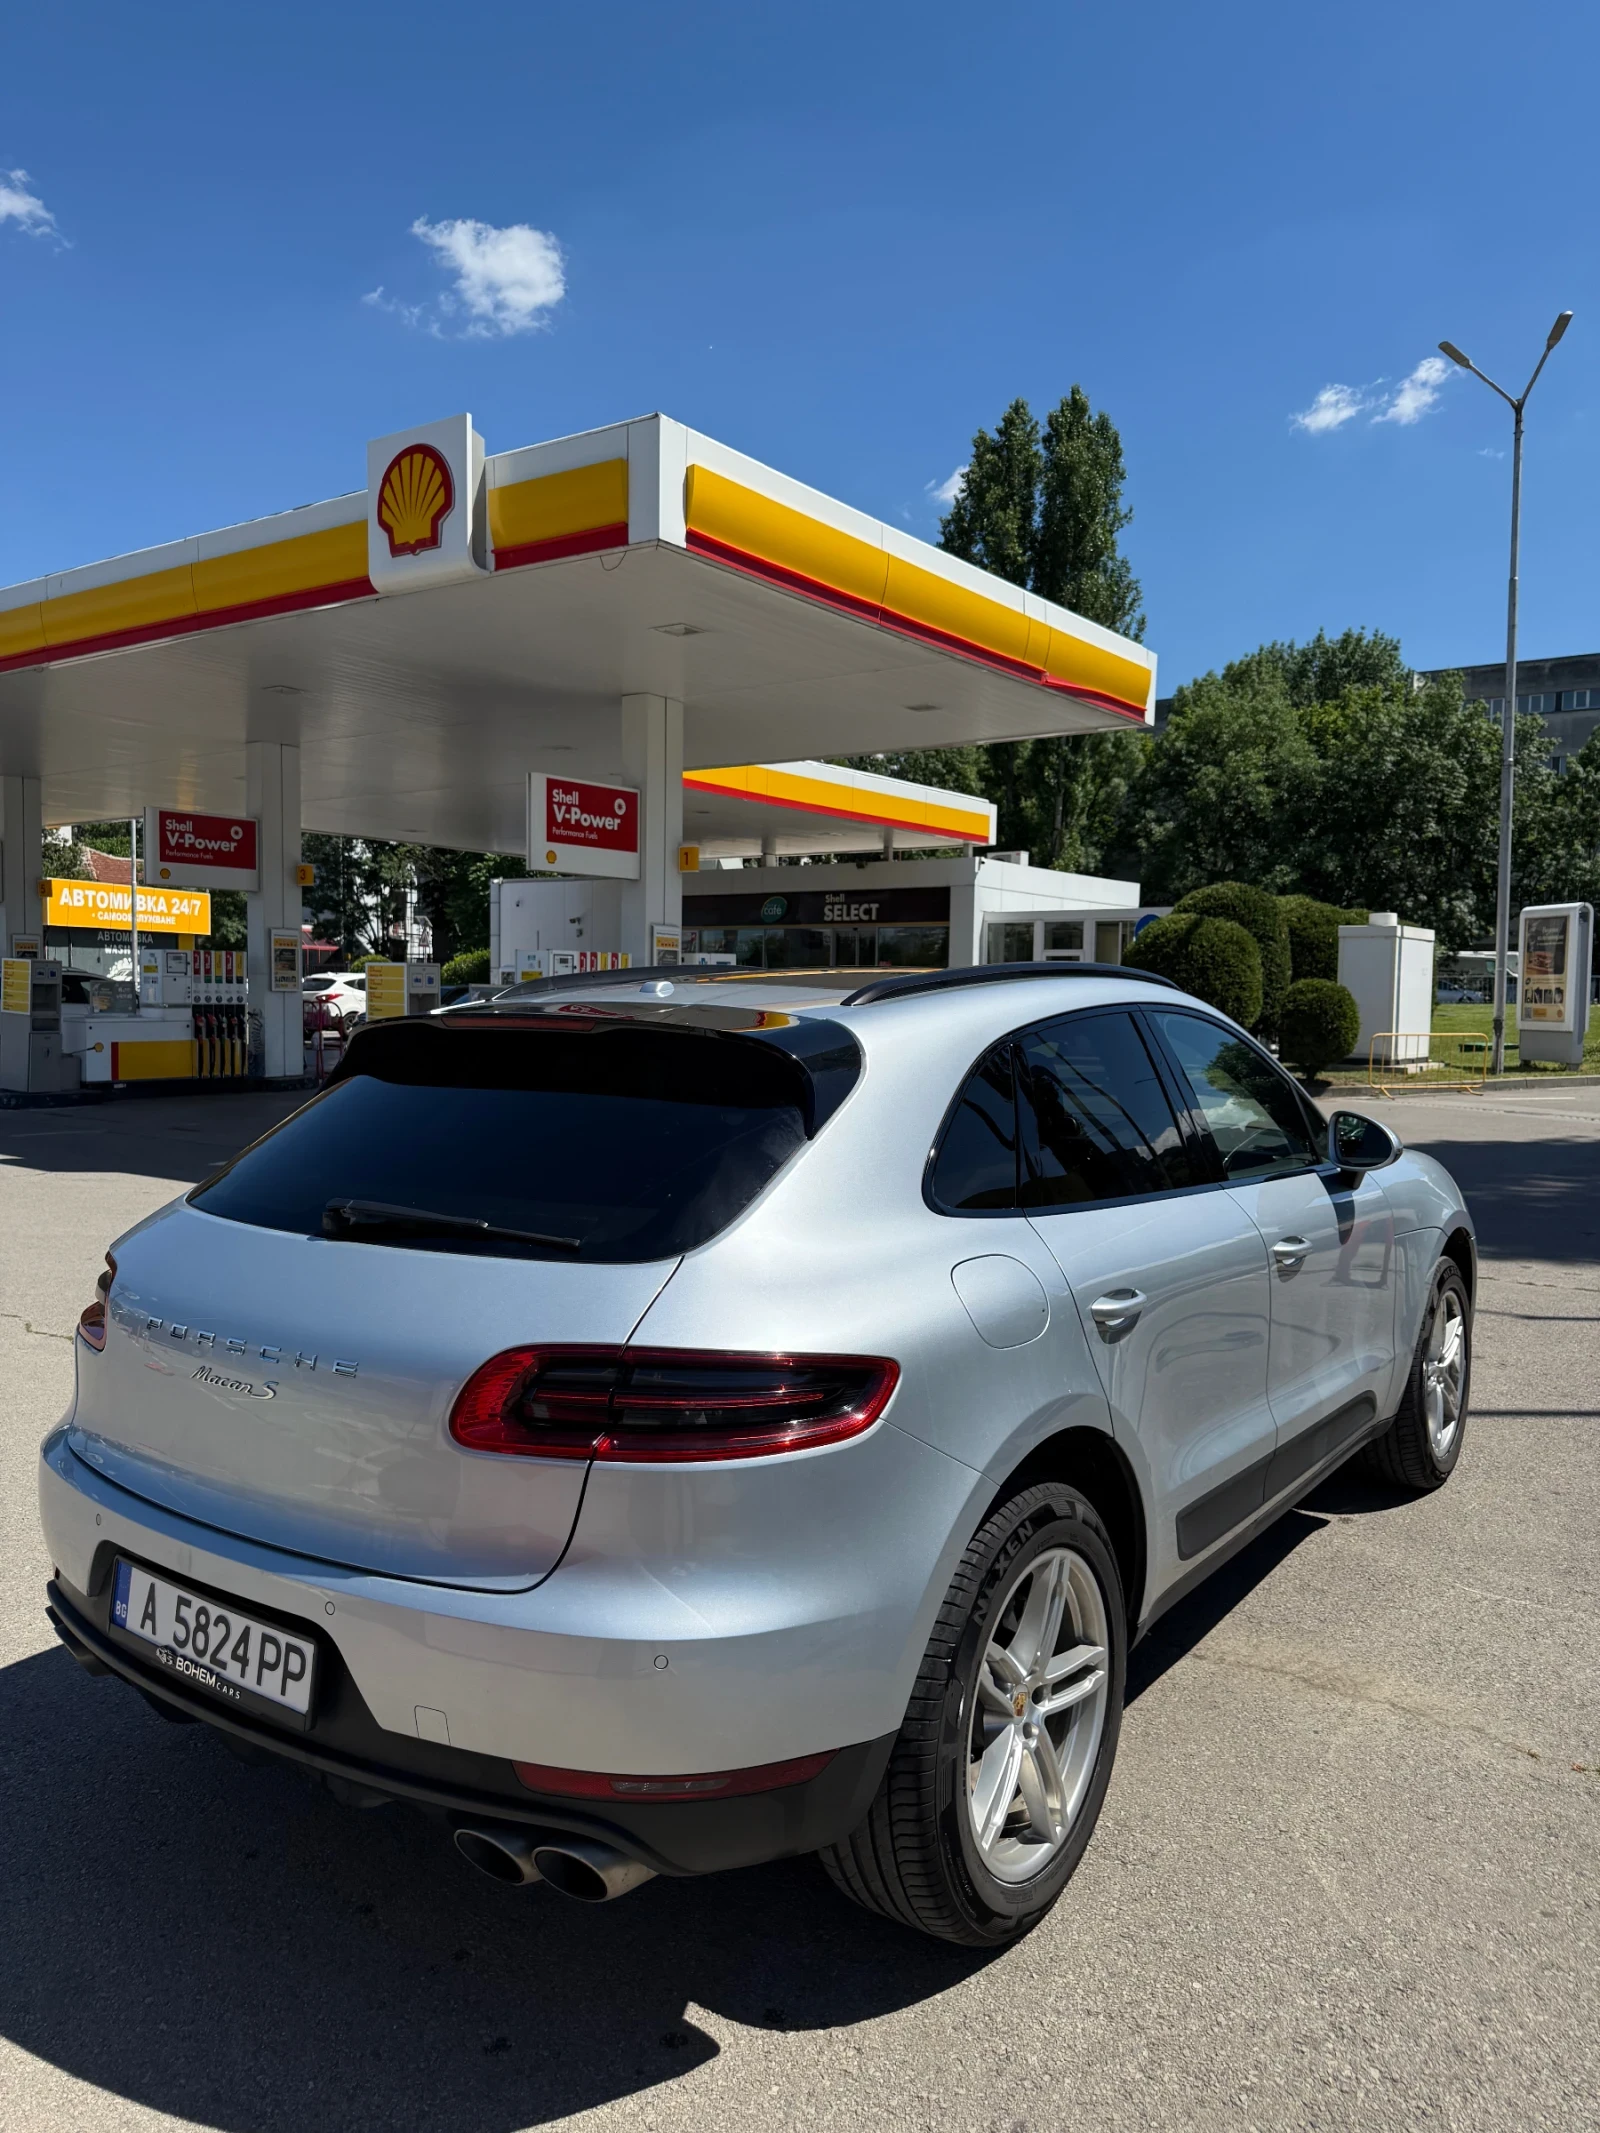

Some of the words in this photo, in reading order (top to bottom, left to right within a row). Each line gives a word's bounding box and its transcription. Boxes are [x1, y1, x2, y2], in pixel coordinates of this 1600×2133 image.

[552, 788, 580, 806] Shell
[165, 819, 193, 833] Shell
[553, 804, 621, 831] V-Power
[166, 831, 238, 853] V-Power
[552, 826, 585, 839] Performance
[585, 830, 599, 840] Fuels
[165, 849, 200, 860] Performance
[300, 868, 306, 881] 3
[59, 887, 169, 914] АВТОМИВКА
[171, 898, 202, 917] 24/7
[825, 893, 845, 904] Shell
[97, 911, 177, 925] САМООБЛУЖВАНЕ
[763, 904, 783, 916] café
[823, 903, 880, 922] SELECT
[146, 1315, 359, 1379] PORSCHE
[190, 1365, 253, 1395] Macan
[249, 1380, 280, 1400] S
[115, 1600, 128, 1619] BG
[139, 1582, 157, 1636] A
[172, 1594, 251, 1680] 5824
[256, 1631, 307, 1697] PP
[175, 1656, 217, 1688] BOHEM
[216, 1681, 242, 1700] CARS
